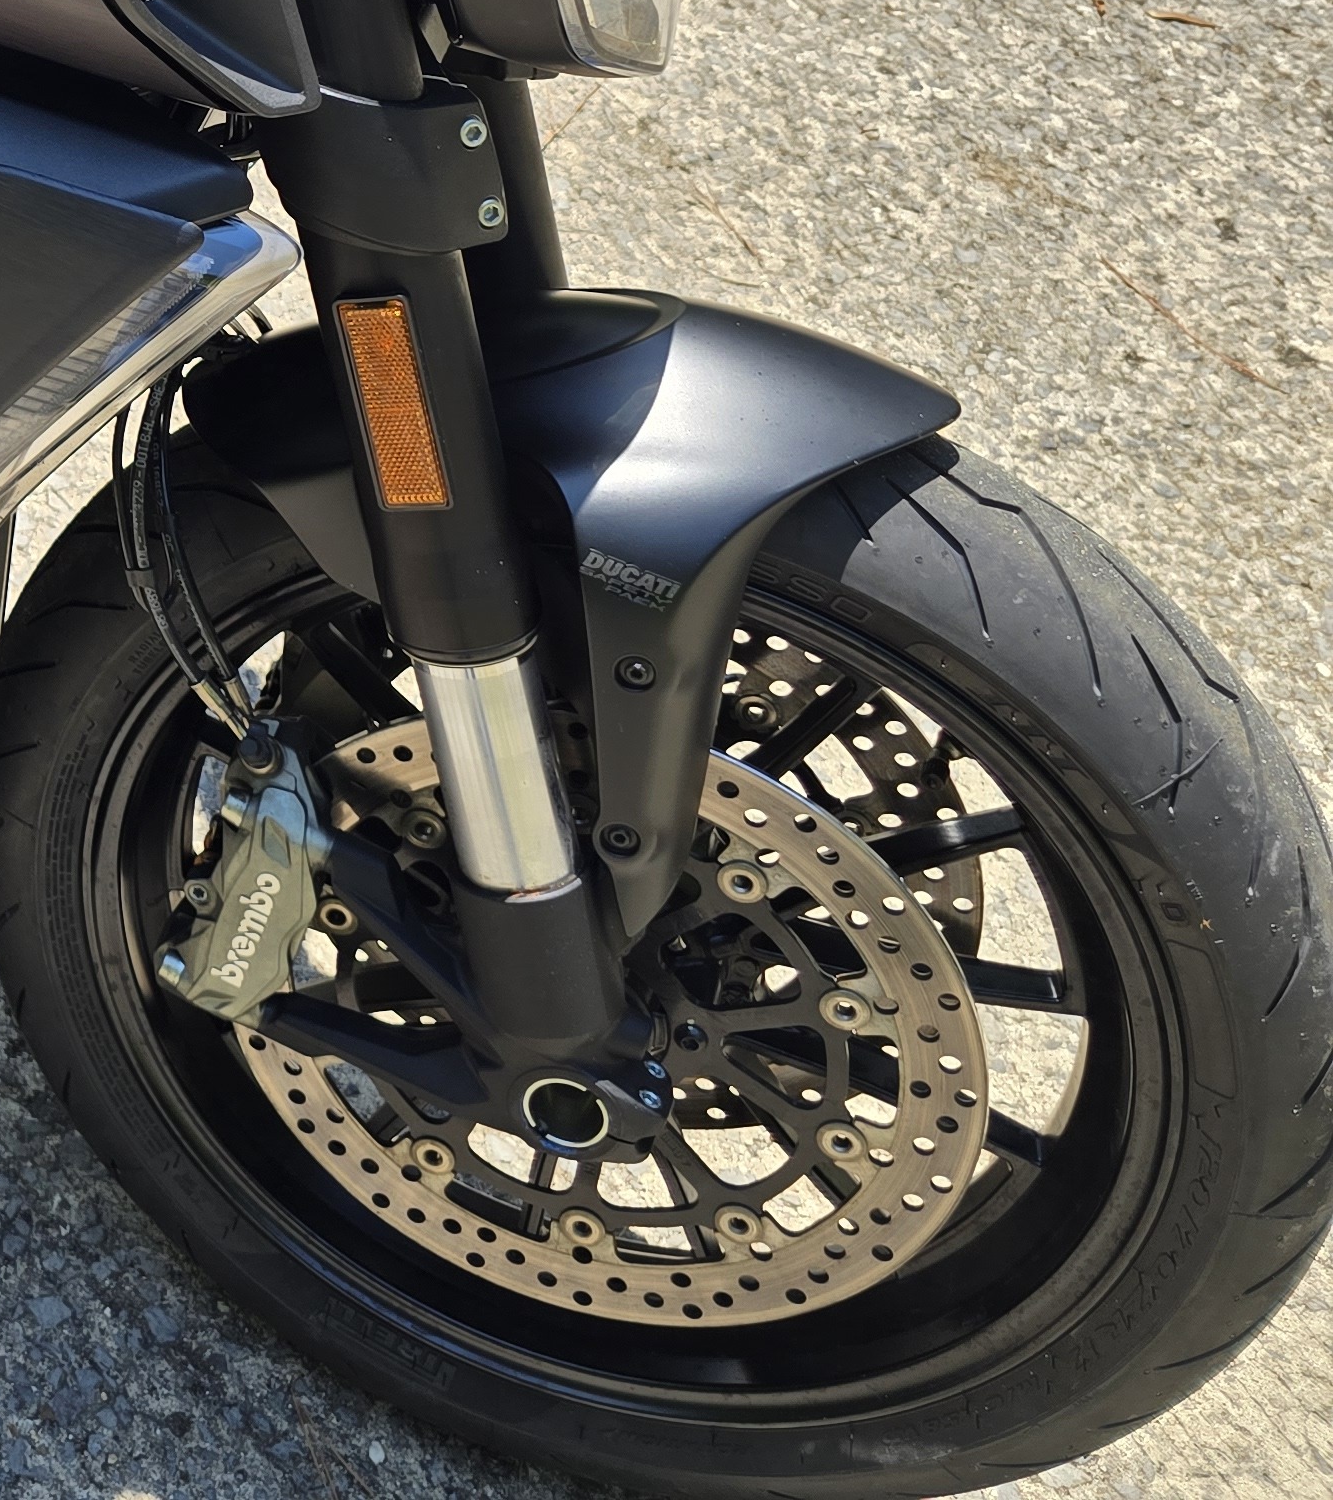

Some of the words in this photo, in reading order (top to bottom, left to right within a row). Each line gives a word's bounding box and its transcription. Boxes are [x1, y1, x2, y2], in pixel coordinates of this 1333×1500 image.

[579, 566, 673, 604] SAFETY
[582, 548, 682, 599] DUCATI
[605, 585, 666, 612] PACK
[210, 873, 281, 988] brembo
[324, 1296, 457, 1392] PIRELLI
